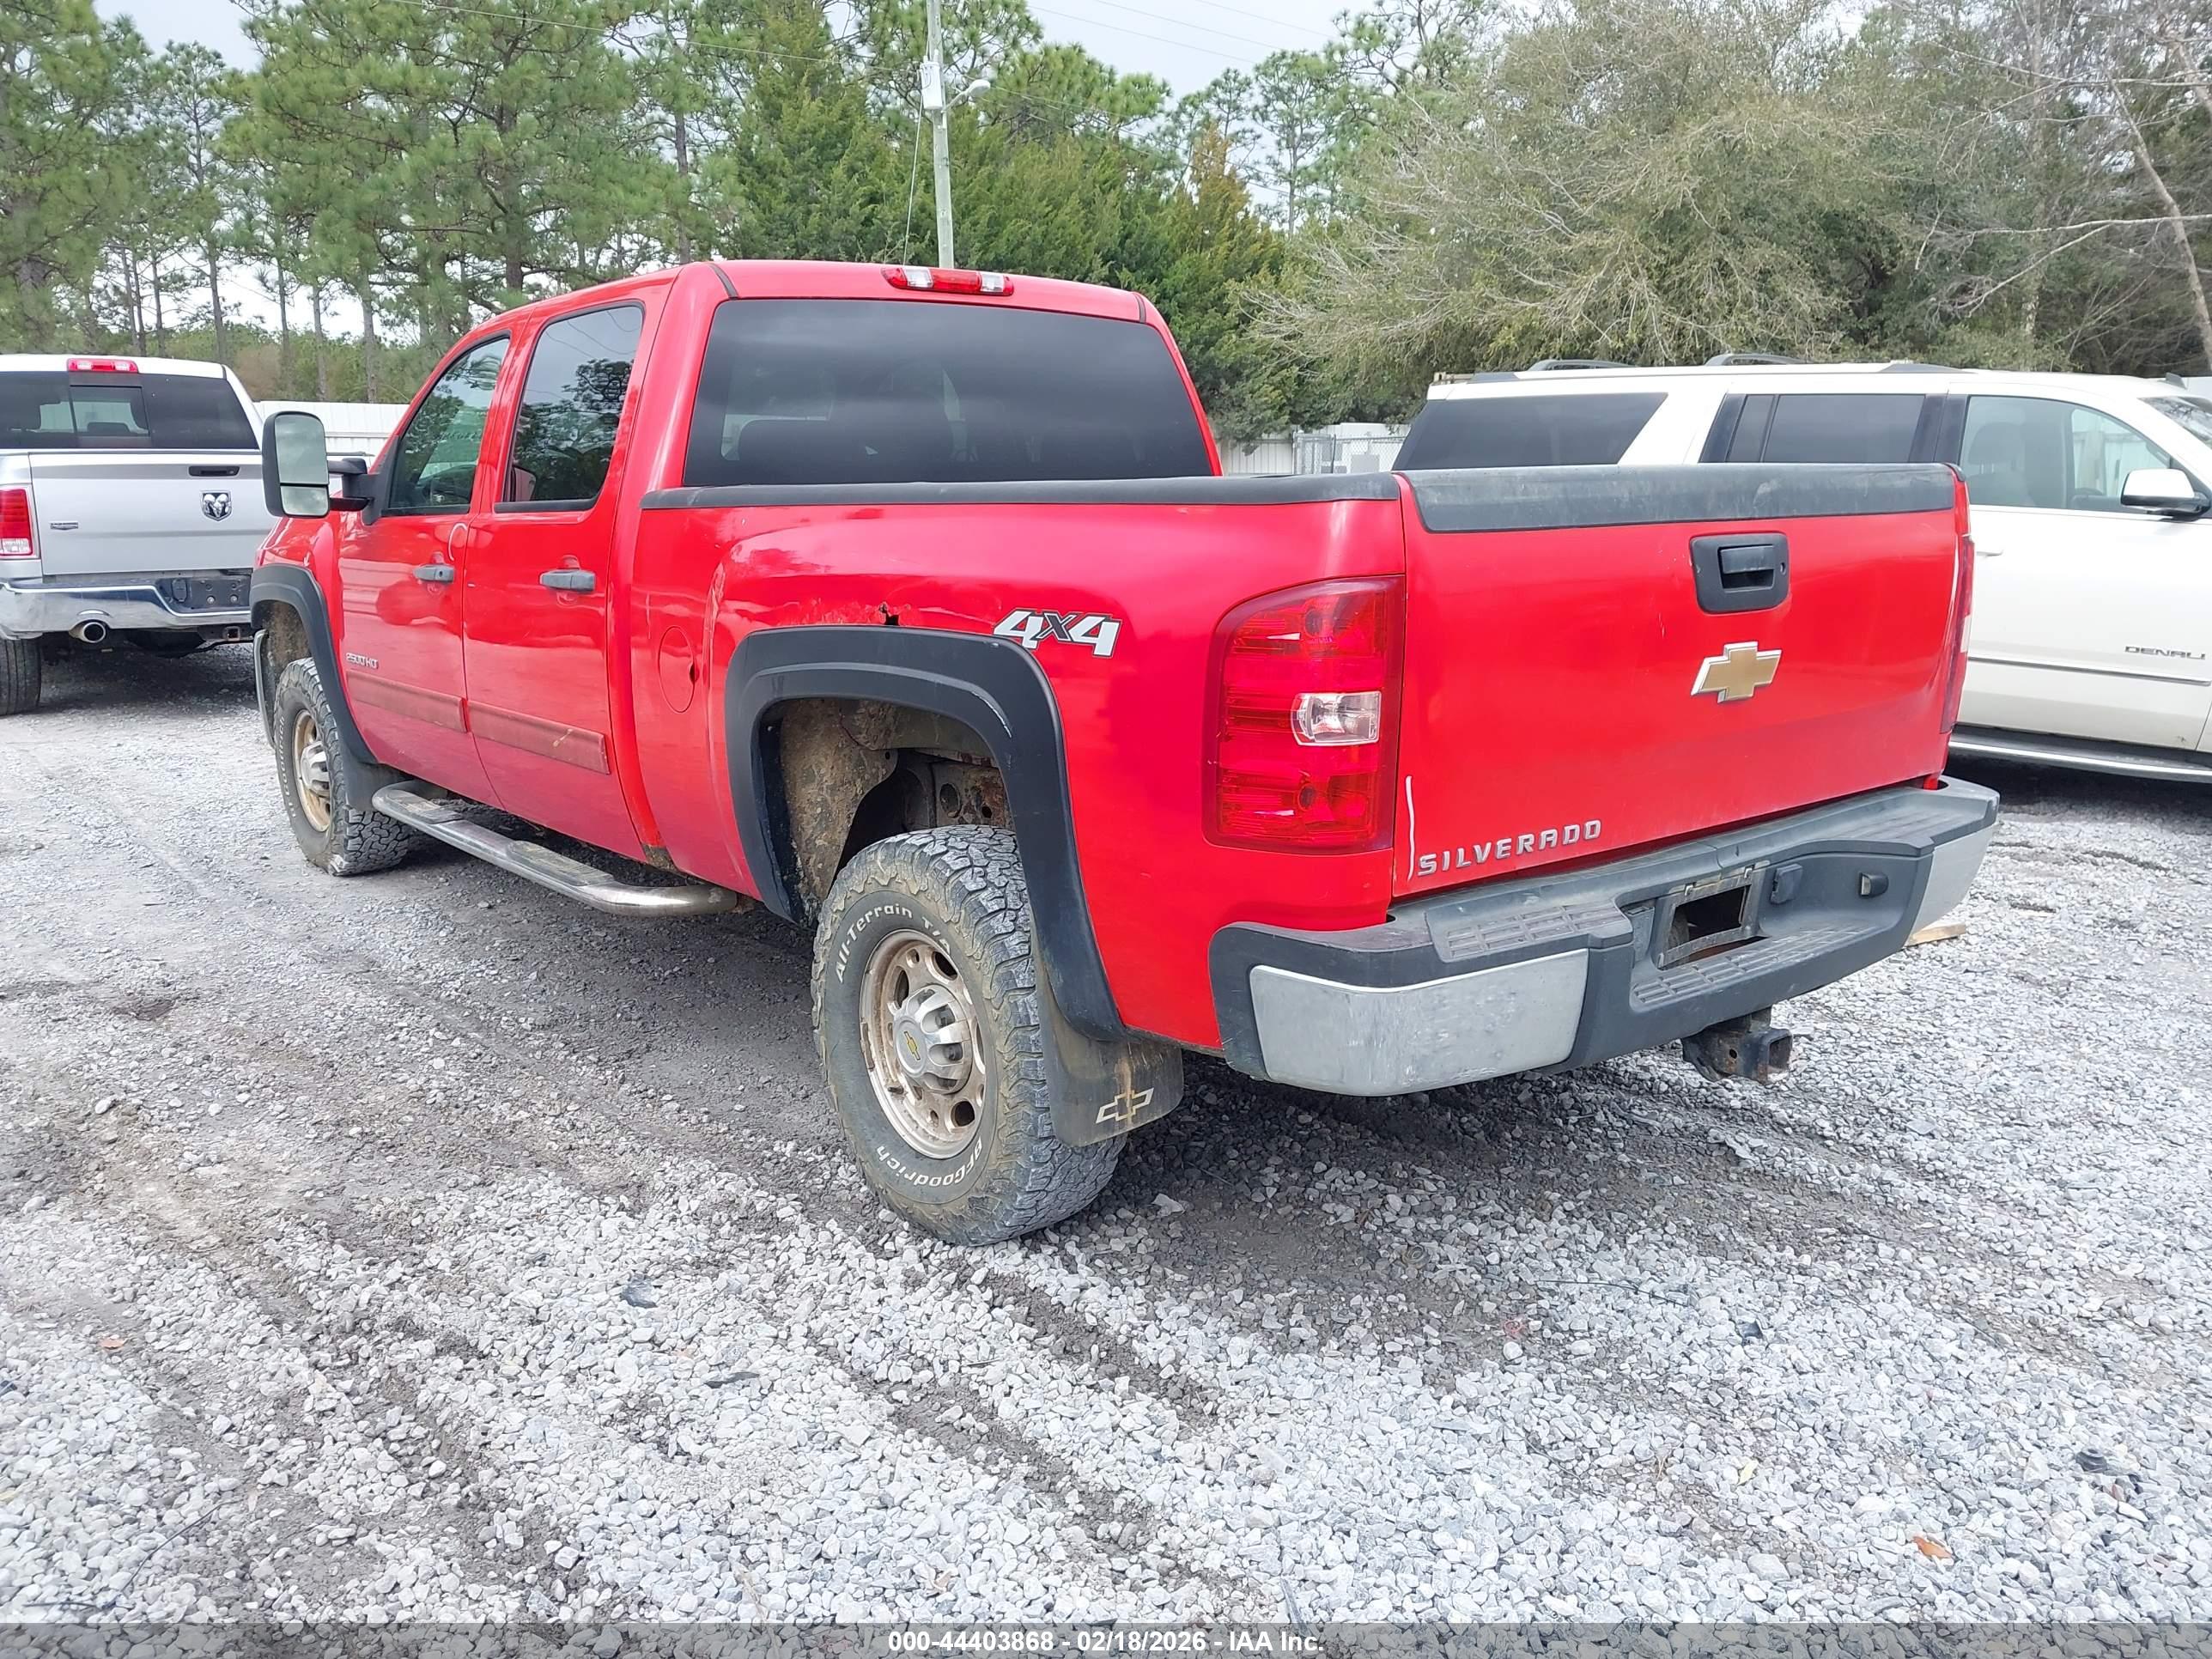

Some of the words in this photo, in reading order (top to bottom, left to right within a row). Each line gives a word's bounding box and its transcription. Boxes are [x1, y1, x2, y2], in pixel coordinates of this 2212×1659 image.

[2125, 646, 2206, 660] DENALI
[1418, 819, 1601, 876] SILVERADO
[836, 903, 913, 983] All-Terrain
[877, 1137, 982, 1187] BFGoodrich
